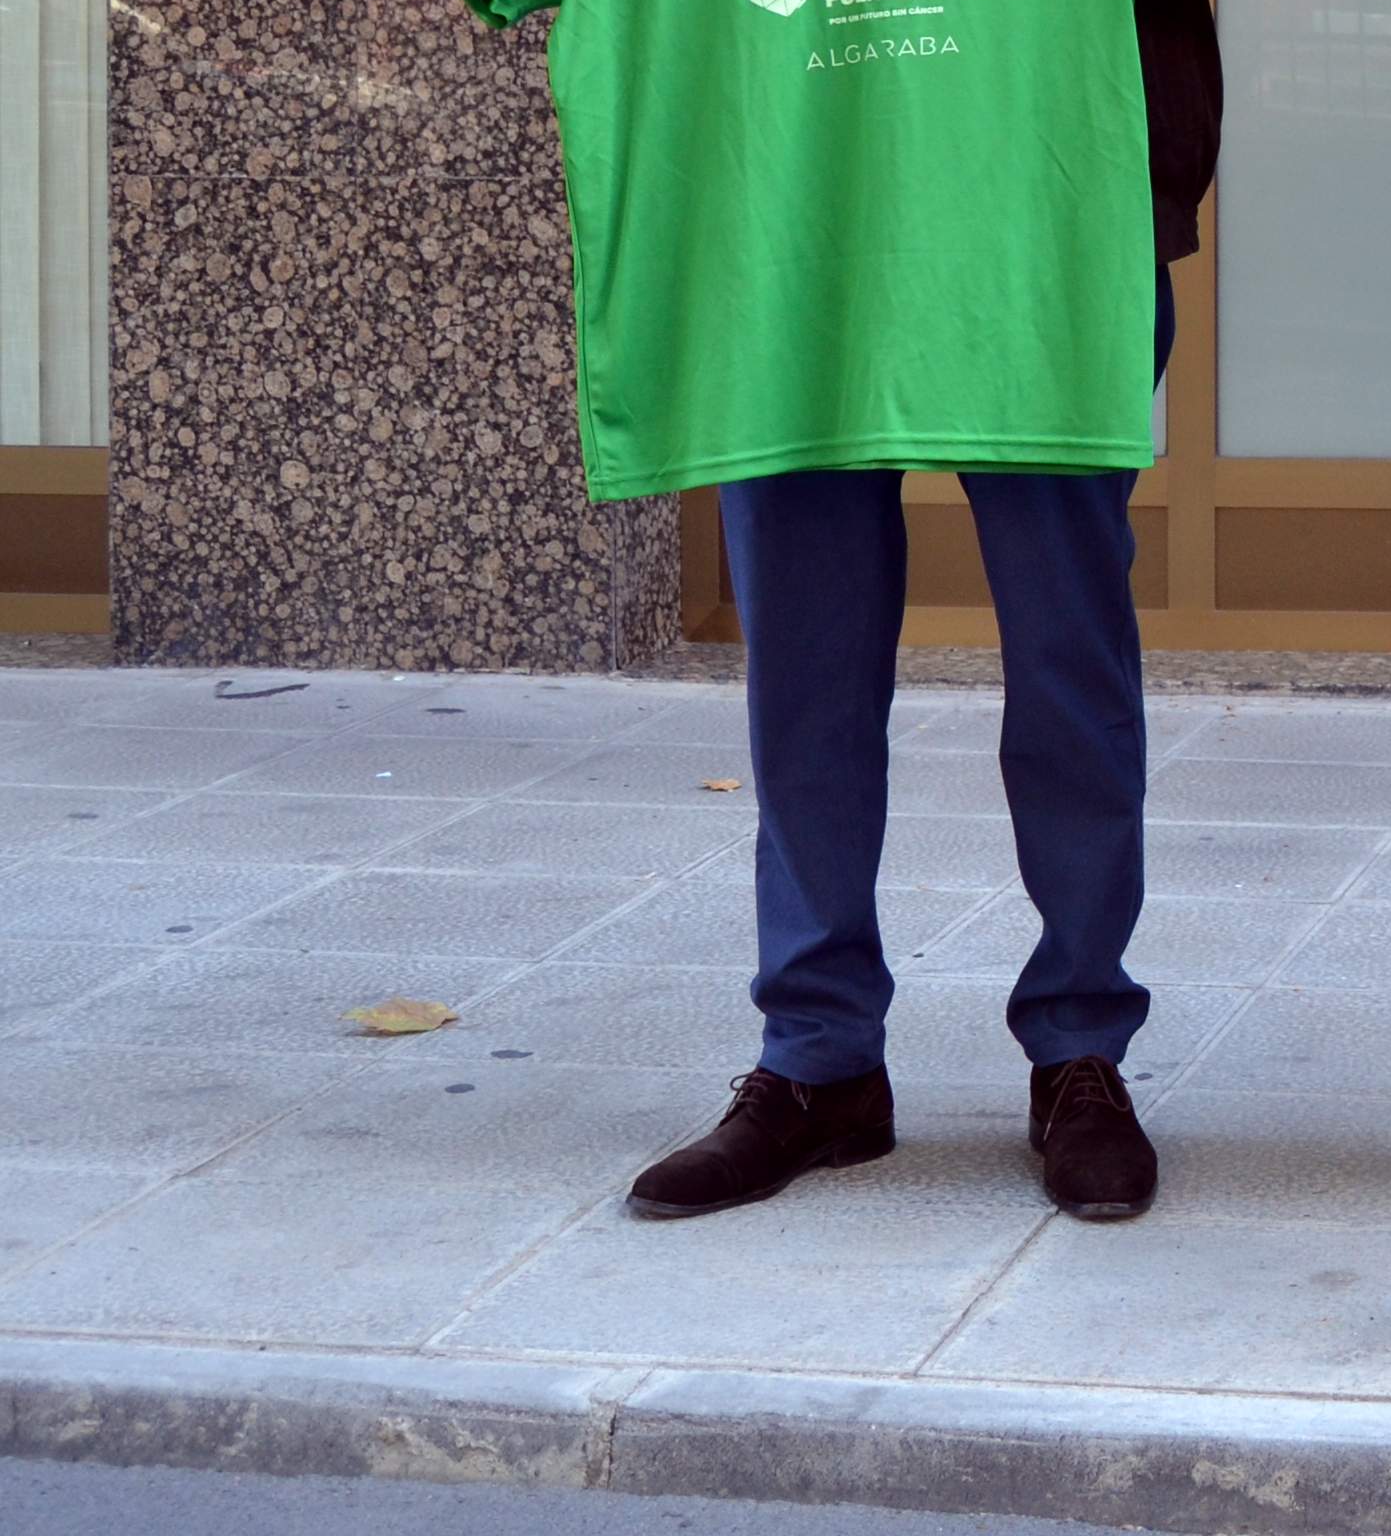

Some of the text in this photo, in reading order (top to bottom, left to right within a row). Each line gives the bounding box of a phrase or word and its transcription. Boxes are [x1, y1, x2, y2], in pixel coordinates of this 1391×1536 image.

[829, 16, 846, 26] POR
[908, 4, 944, 16] CÁNCER
[806, 35, 960, 71] ALGARABA
